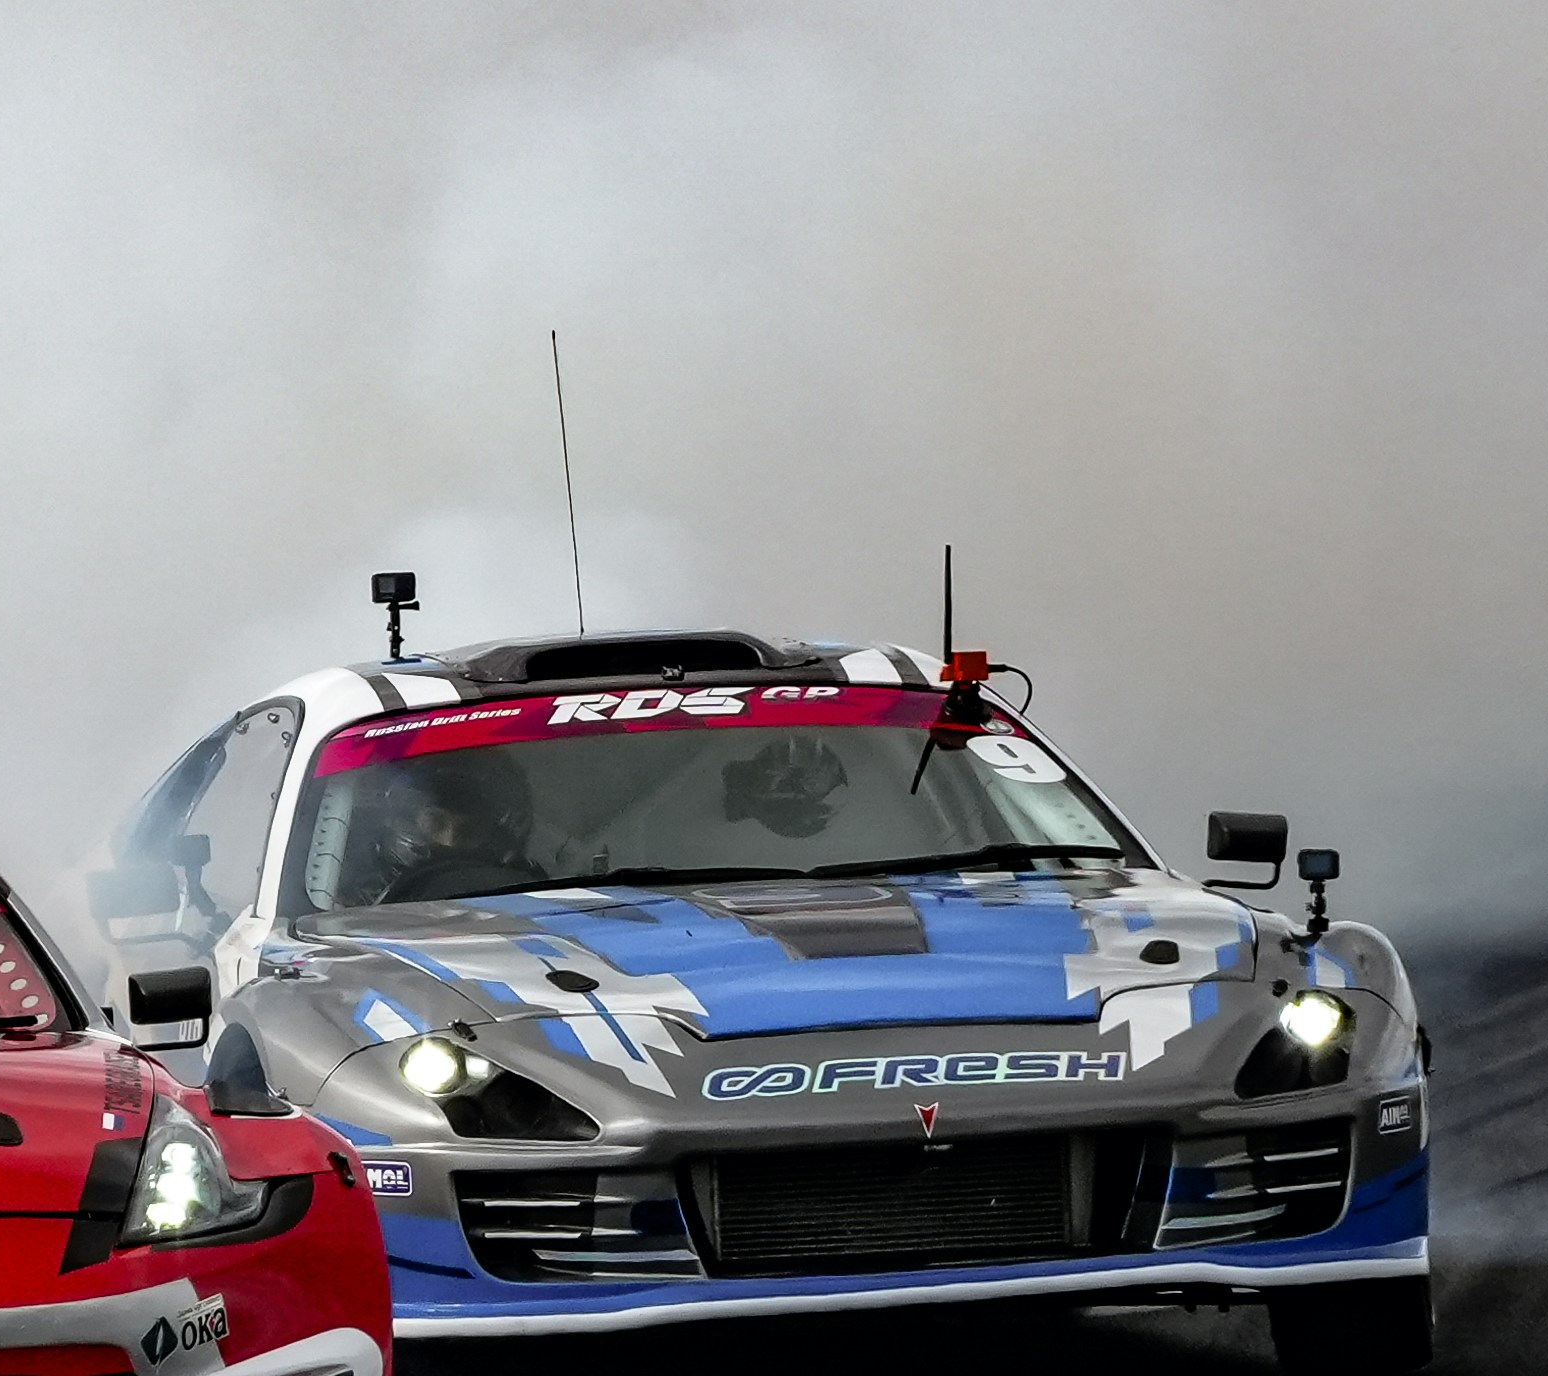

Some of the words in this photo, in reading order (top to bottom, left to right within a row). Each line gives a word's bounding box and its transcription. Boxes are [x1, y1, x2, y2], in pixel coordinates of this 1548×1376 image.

[364, 718, 429, 738] Russian
[430, 712, 467, 728] Drift
[468, 705, 522, 722] Series
[547, 687, 757, 725] RDS
[967, 735, 1067, 783] 9
[366, 1168, 409, 1190] MOL
